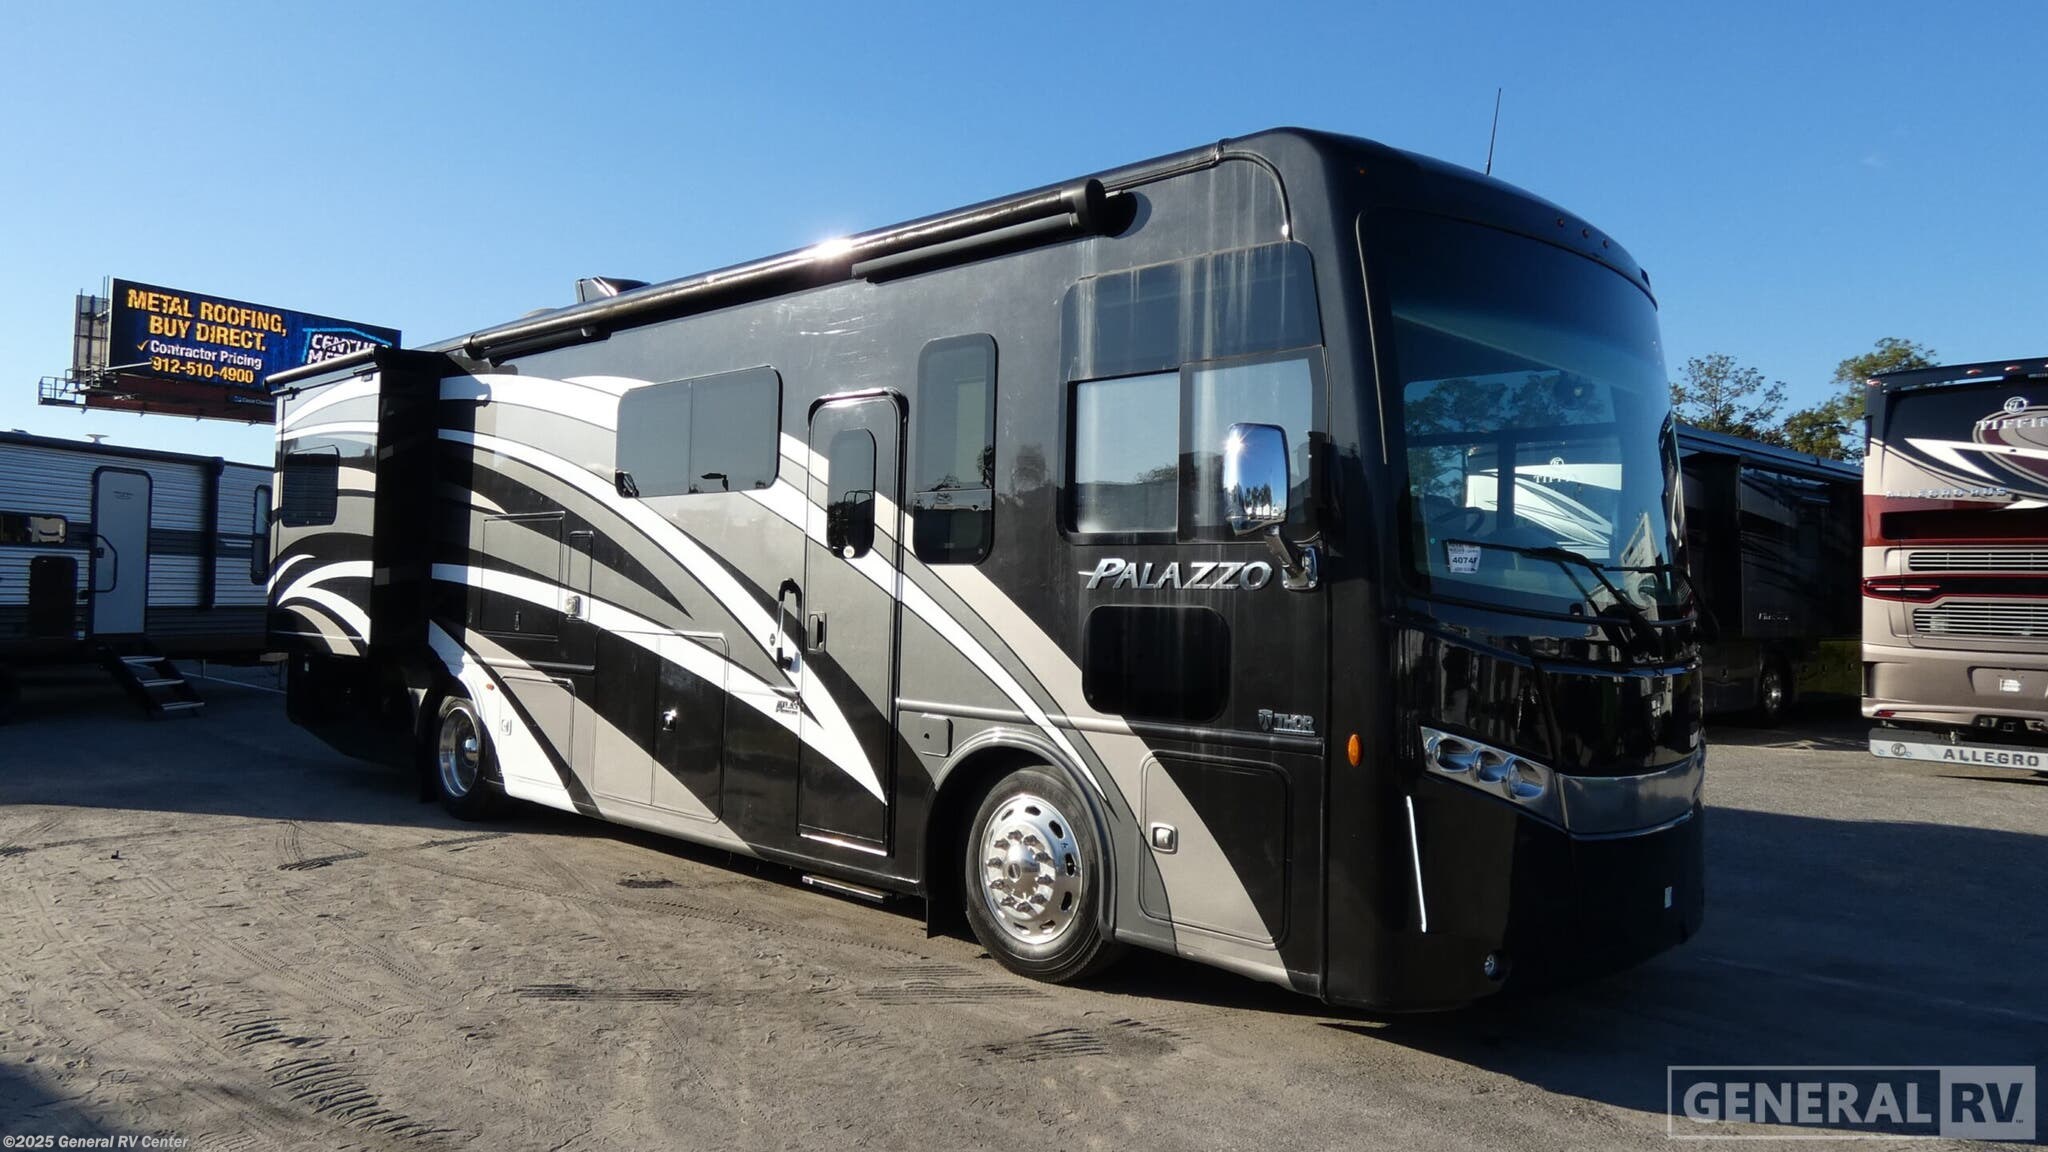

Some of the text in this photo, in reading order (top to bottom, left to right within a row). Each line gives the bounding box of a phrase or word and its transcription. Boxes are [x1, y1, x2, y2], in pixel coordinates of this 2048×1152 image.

[128, 288, 287, 337] METAL ROOFING,
[149, 314, 266, 351] BUY DIRECT.
[150, 340, 262, 370] Contractor Pricing
[152, 356, 254, 383] 912-510-4900
[1085, 557, 1274, 591] PALAZZO
[1274, 712, 1314, 731] THOR
[1943, 748, 2039, 767] ALLEGRO
